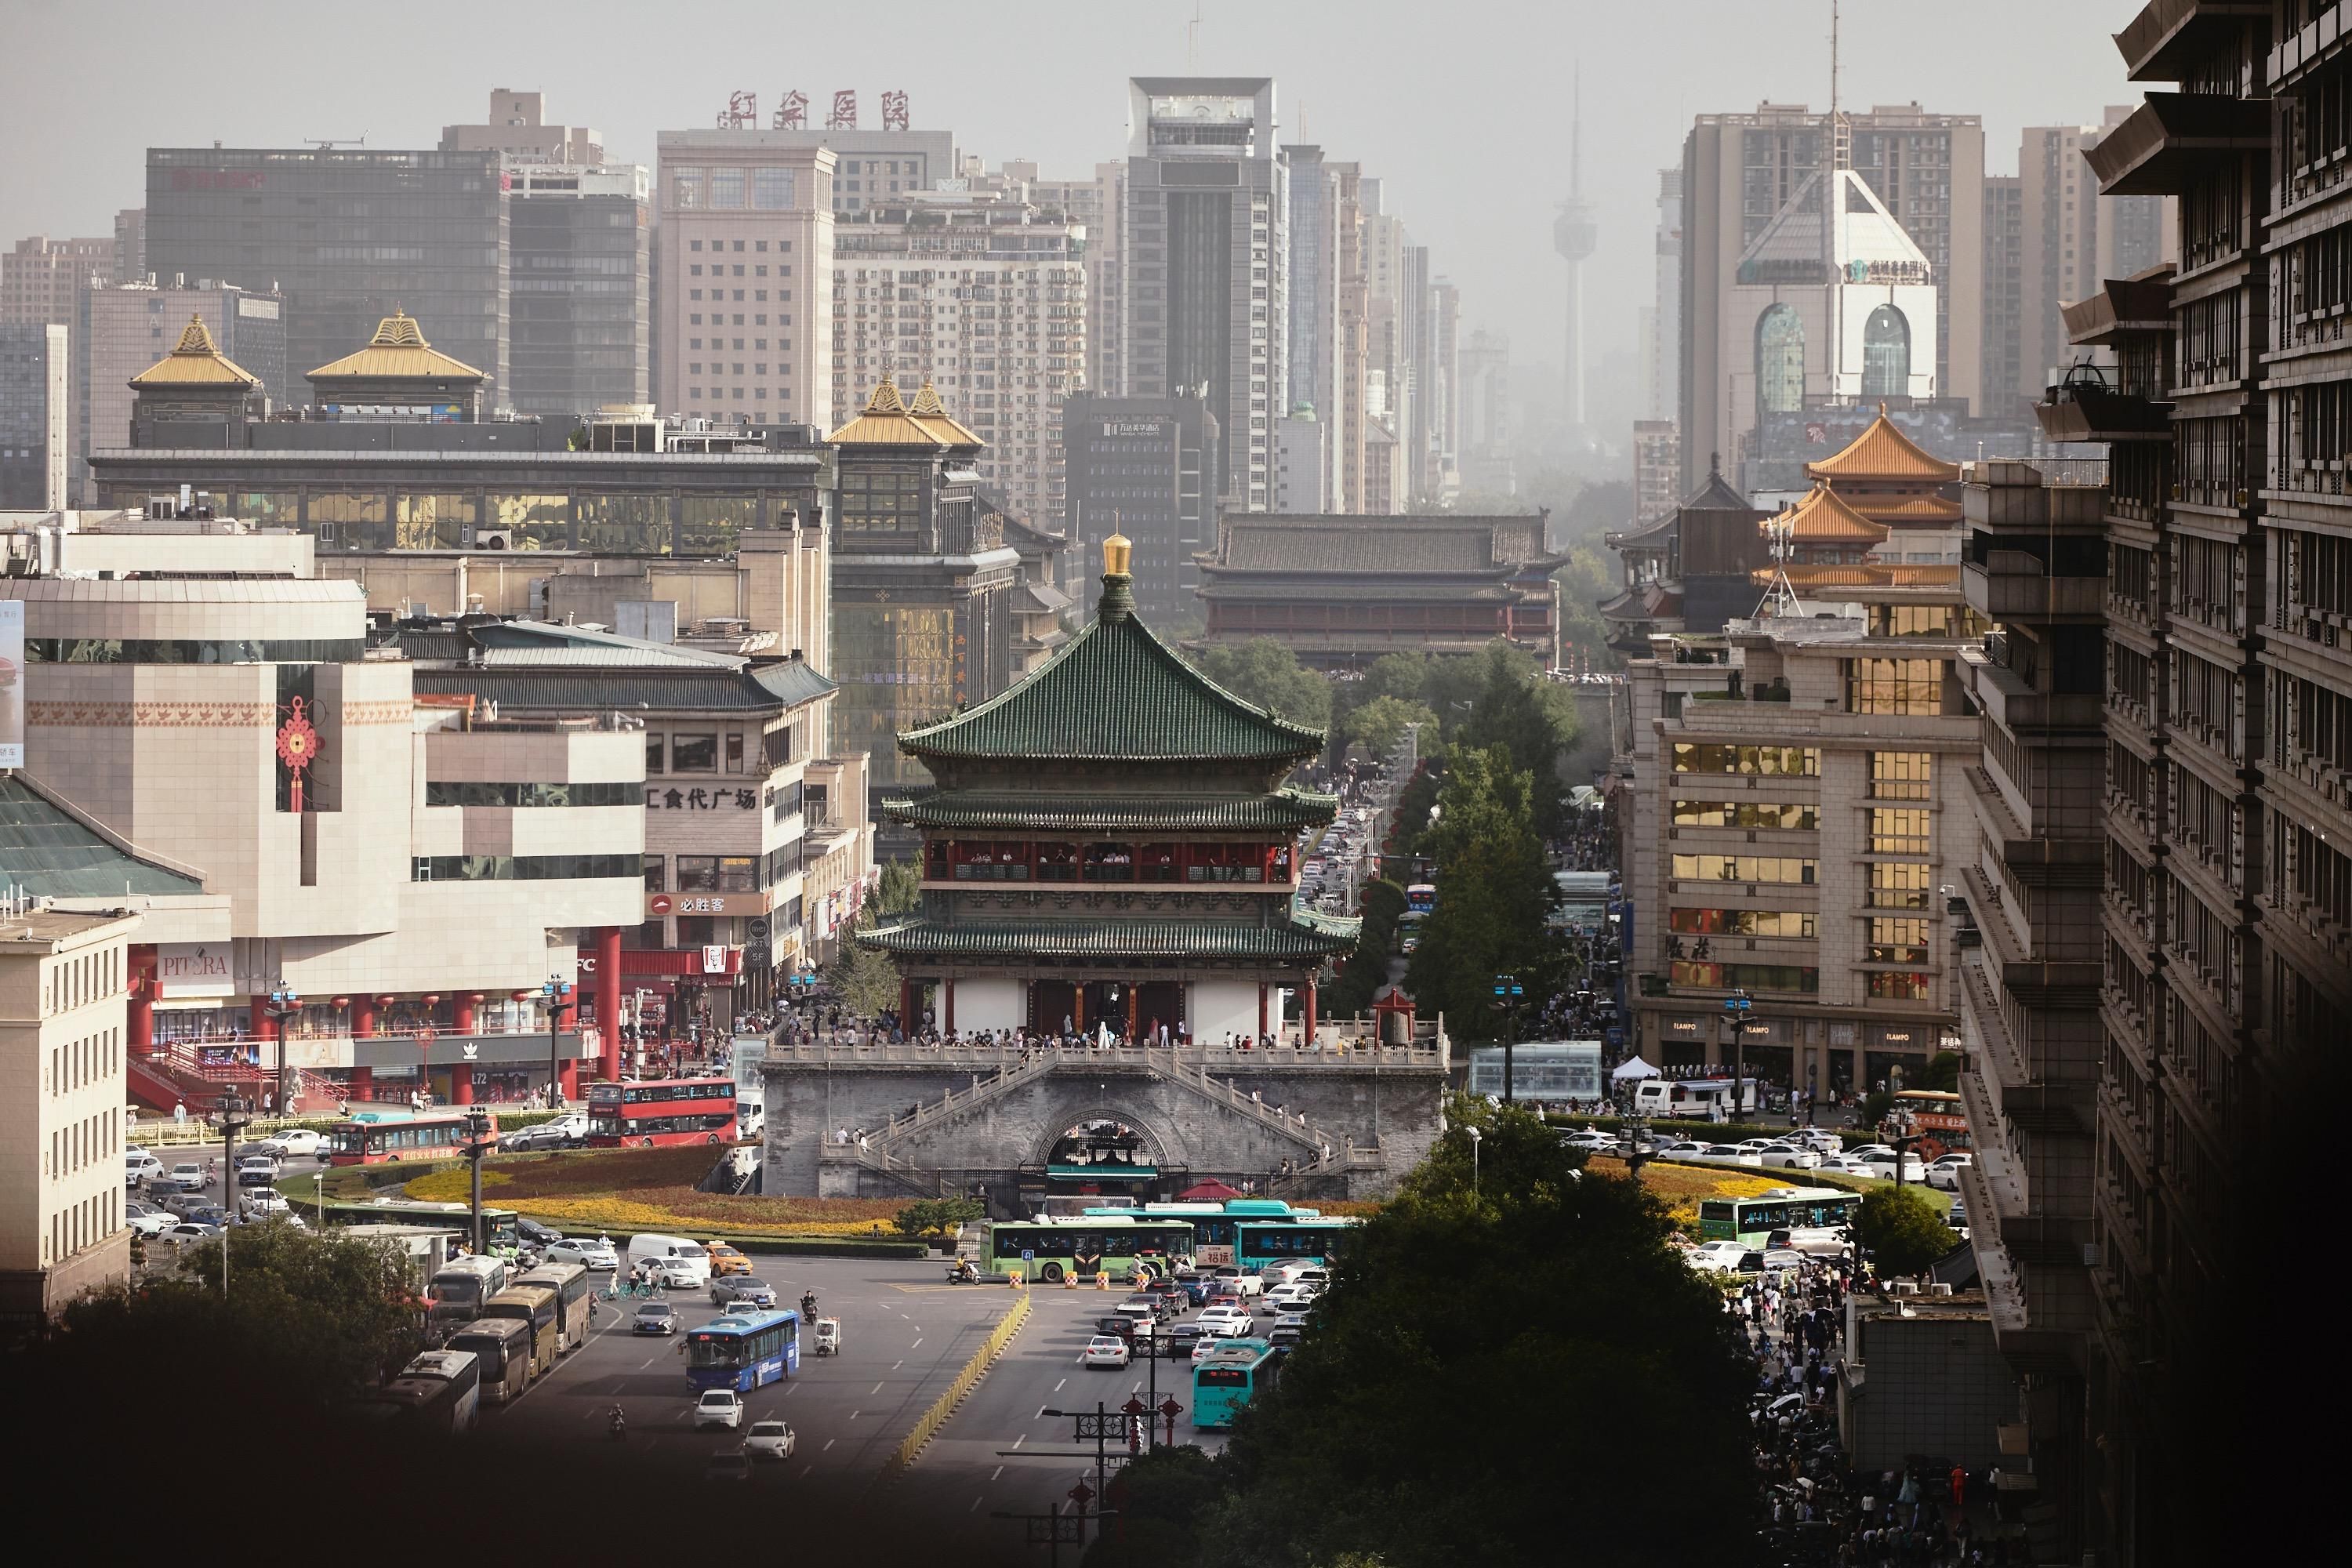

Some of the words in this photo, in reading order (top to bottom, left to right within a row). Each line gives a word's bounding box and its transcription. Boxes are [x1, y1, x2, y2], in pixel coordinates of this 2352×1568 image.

[729, 89, 909, 132] 红会医院
[681, 898, 724, 913] 必胜客
[753, 953, 764, 961] 5F
[577, 958, 596, 971] FC
[472, 1072, 487, 1085] L72
[403, 1150, 430, 1161] 红红火火
